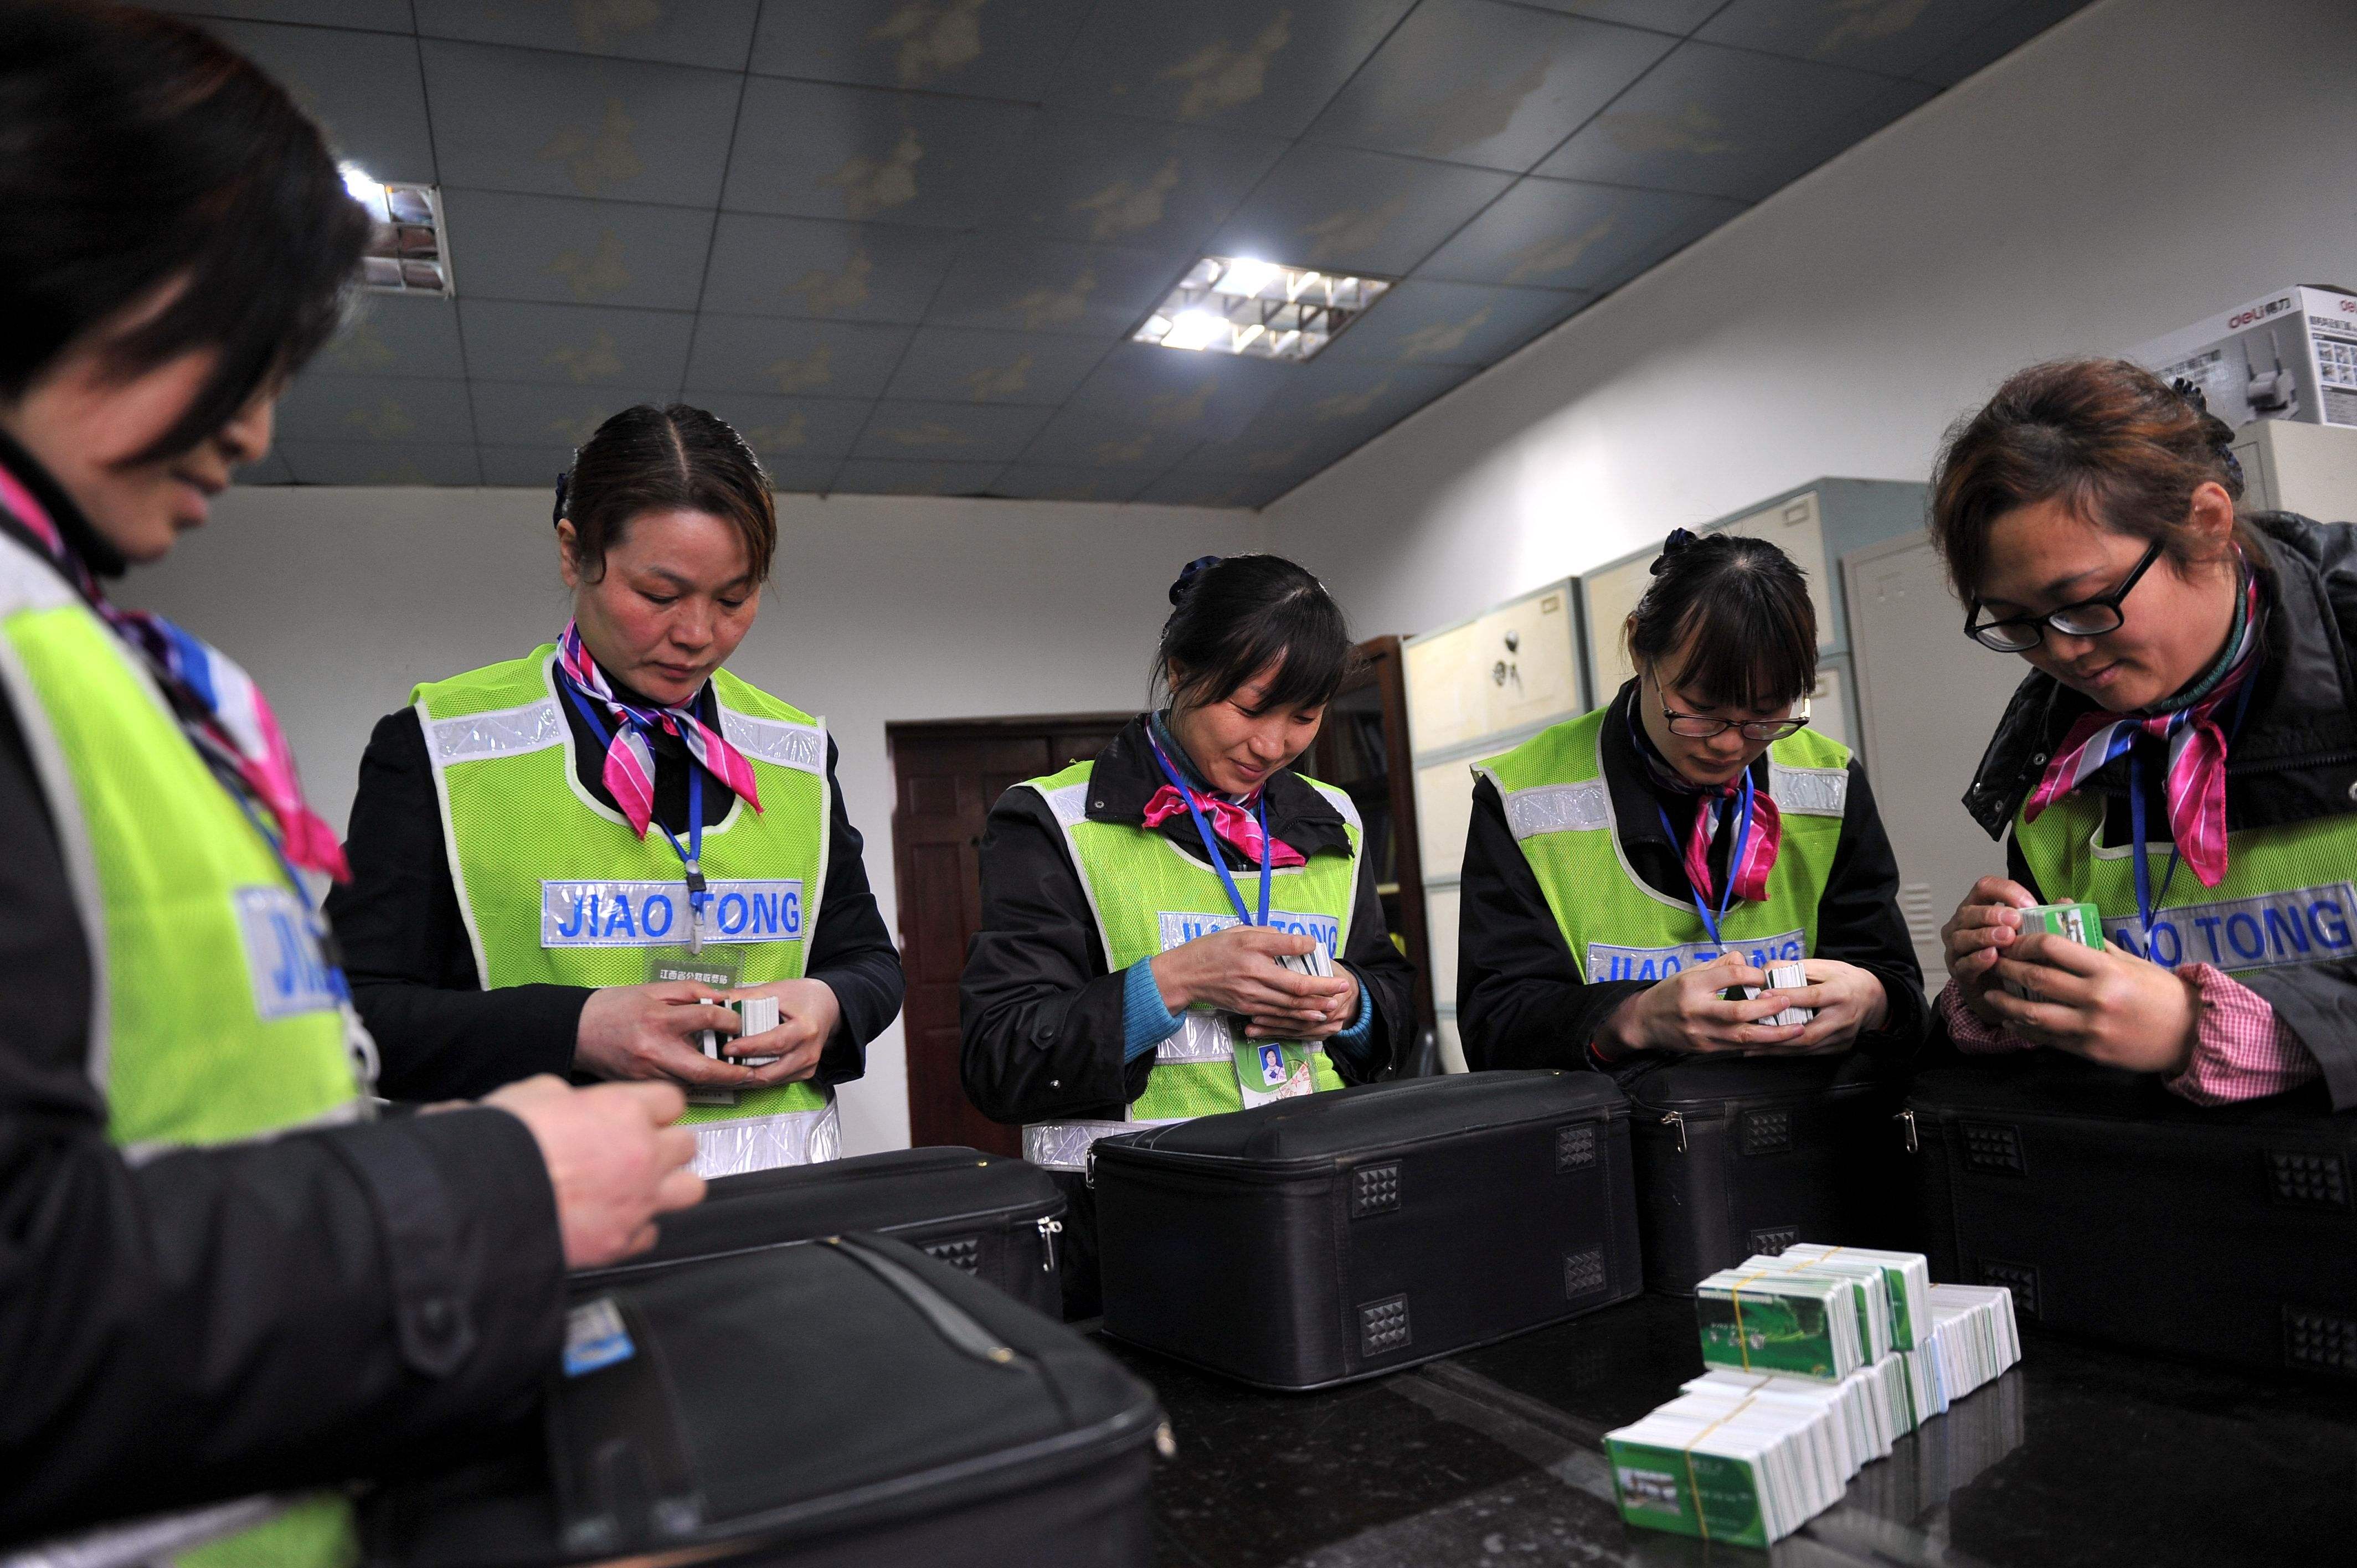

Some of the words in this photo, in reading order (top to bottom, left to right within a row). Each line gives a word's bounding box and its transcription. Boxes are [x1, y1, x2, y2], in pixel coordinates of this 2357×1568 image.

[559, 894, 673, 938] JIAO
[700, 892, 799, 935] TONG
[2195, 900, 2353, 964] TONG
[1694, 941, 1799, 969] TNG
